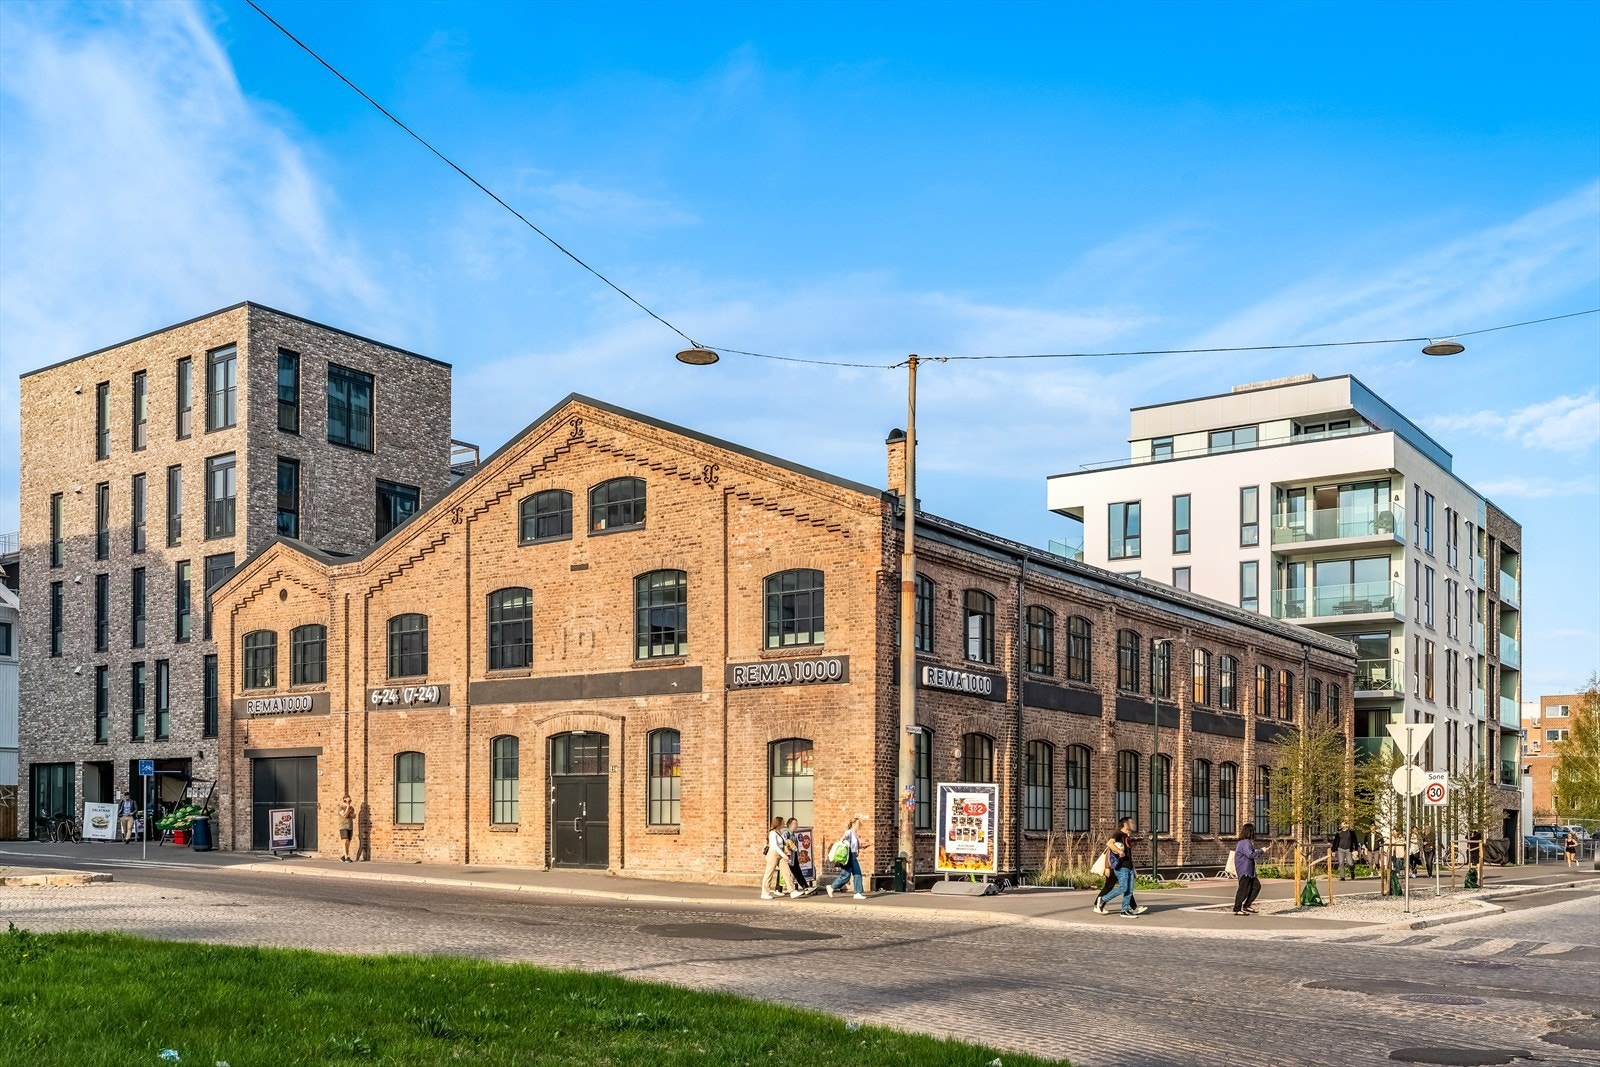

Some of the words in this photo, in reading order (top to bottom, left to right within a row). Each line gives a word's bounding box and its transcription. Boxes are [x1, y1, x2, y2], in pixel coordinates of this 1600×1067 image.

[733, 663, 792, 685] REMA
[793, 660, 842, 681] 1000
[922, 666, 963, 691] REMA
[962, 673, 992, 695] 1000
[371, 688, 399, 704] 6-24
[403, 686, 440, 704] (7-24)
[247, 699, 284, 714] REMA
[282, 696, 312, 711] 1000
[1430, 787, 1442, 797] 30
